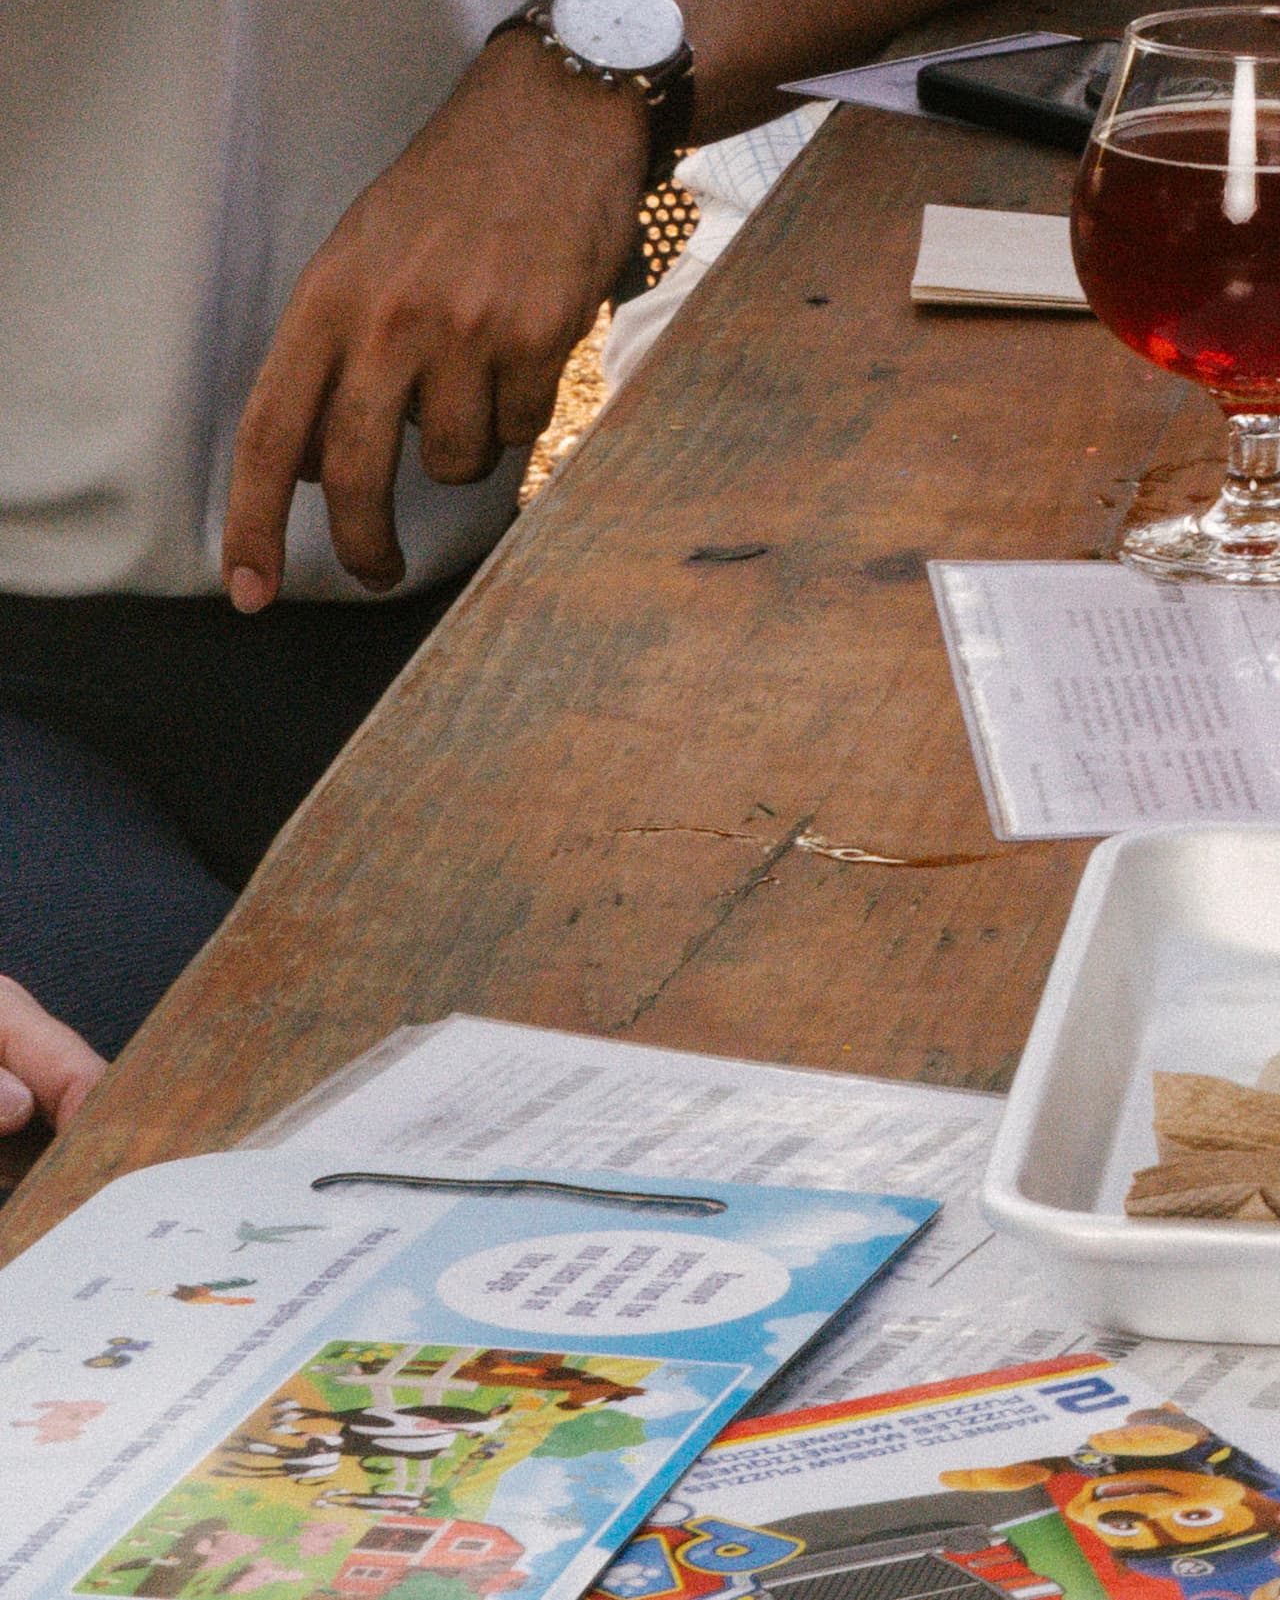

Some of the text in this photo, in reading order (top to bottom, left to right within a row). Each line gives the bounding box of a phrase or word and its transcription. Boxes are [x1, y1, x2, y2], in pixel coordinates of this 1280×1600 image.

[899, 1394, 1025, 1426] PUZZLES
[1037, 1377, 1131, 1414] 2
[912, 1405, 1037, 1435] PUZZLES
[683, 1413, 1051, 1494] MAGNETIC JIGSAW PUZZLES
